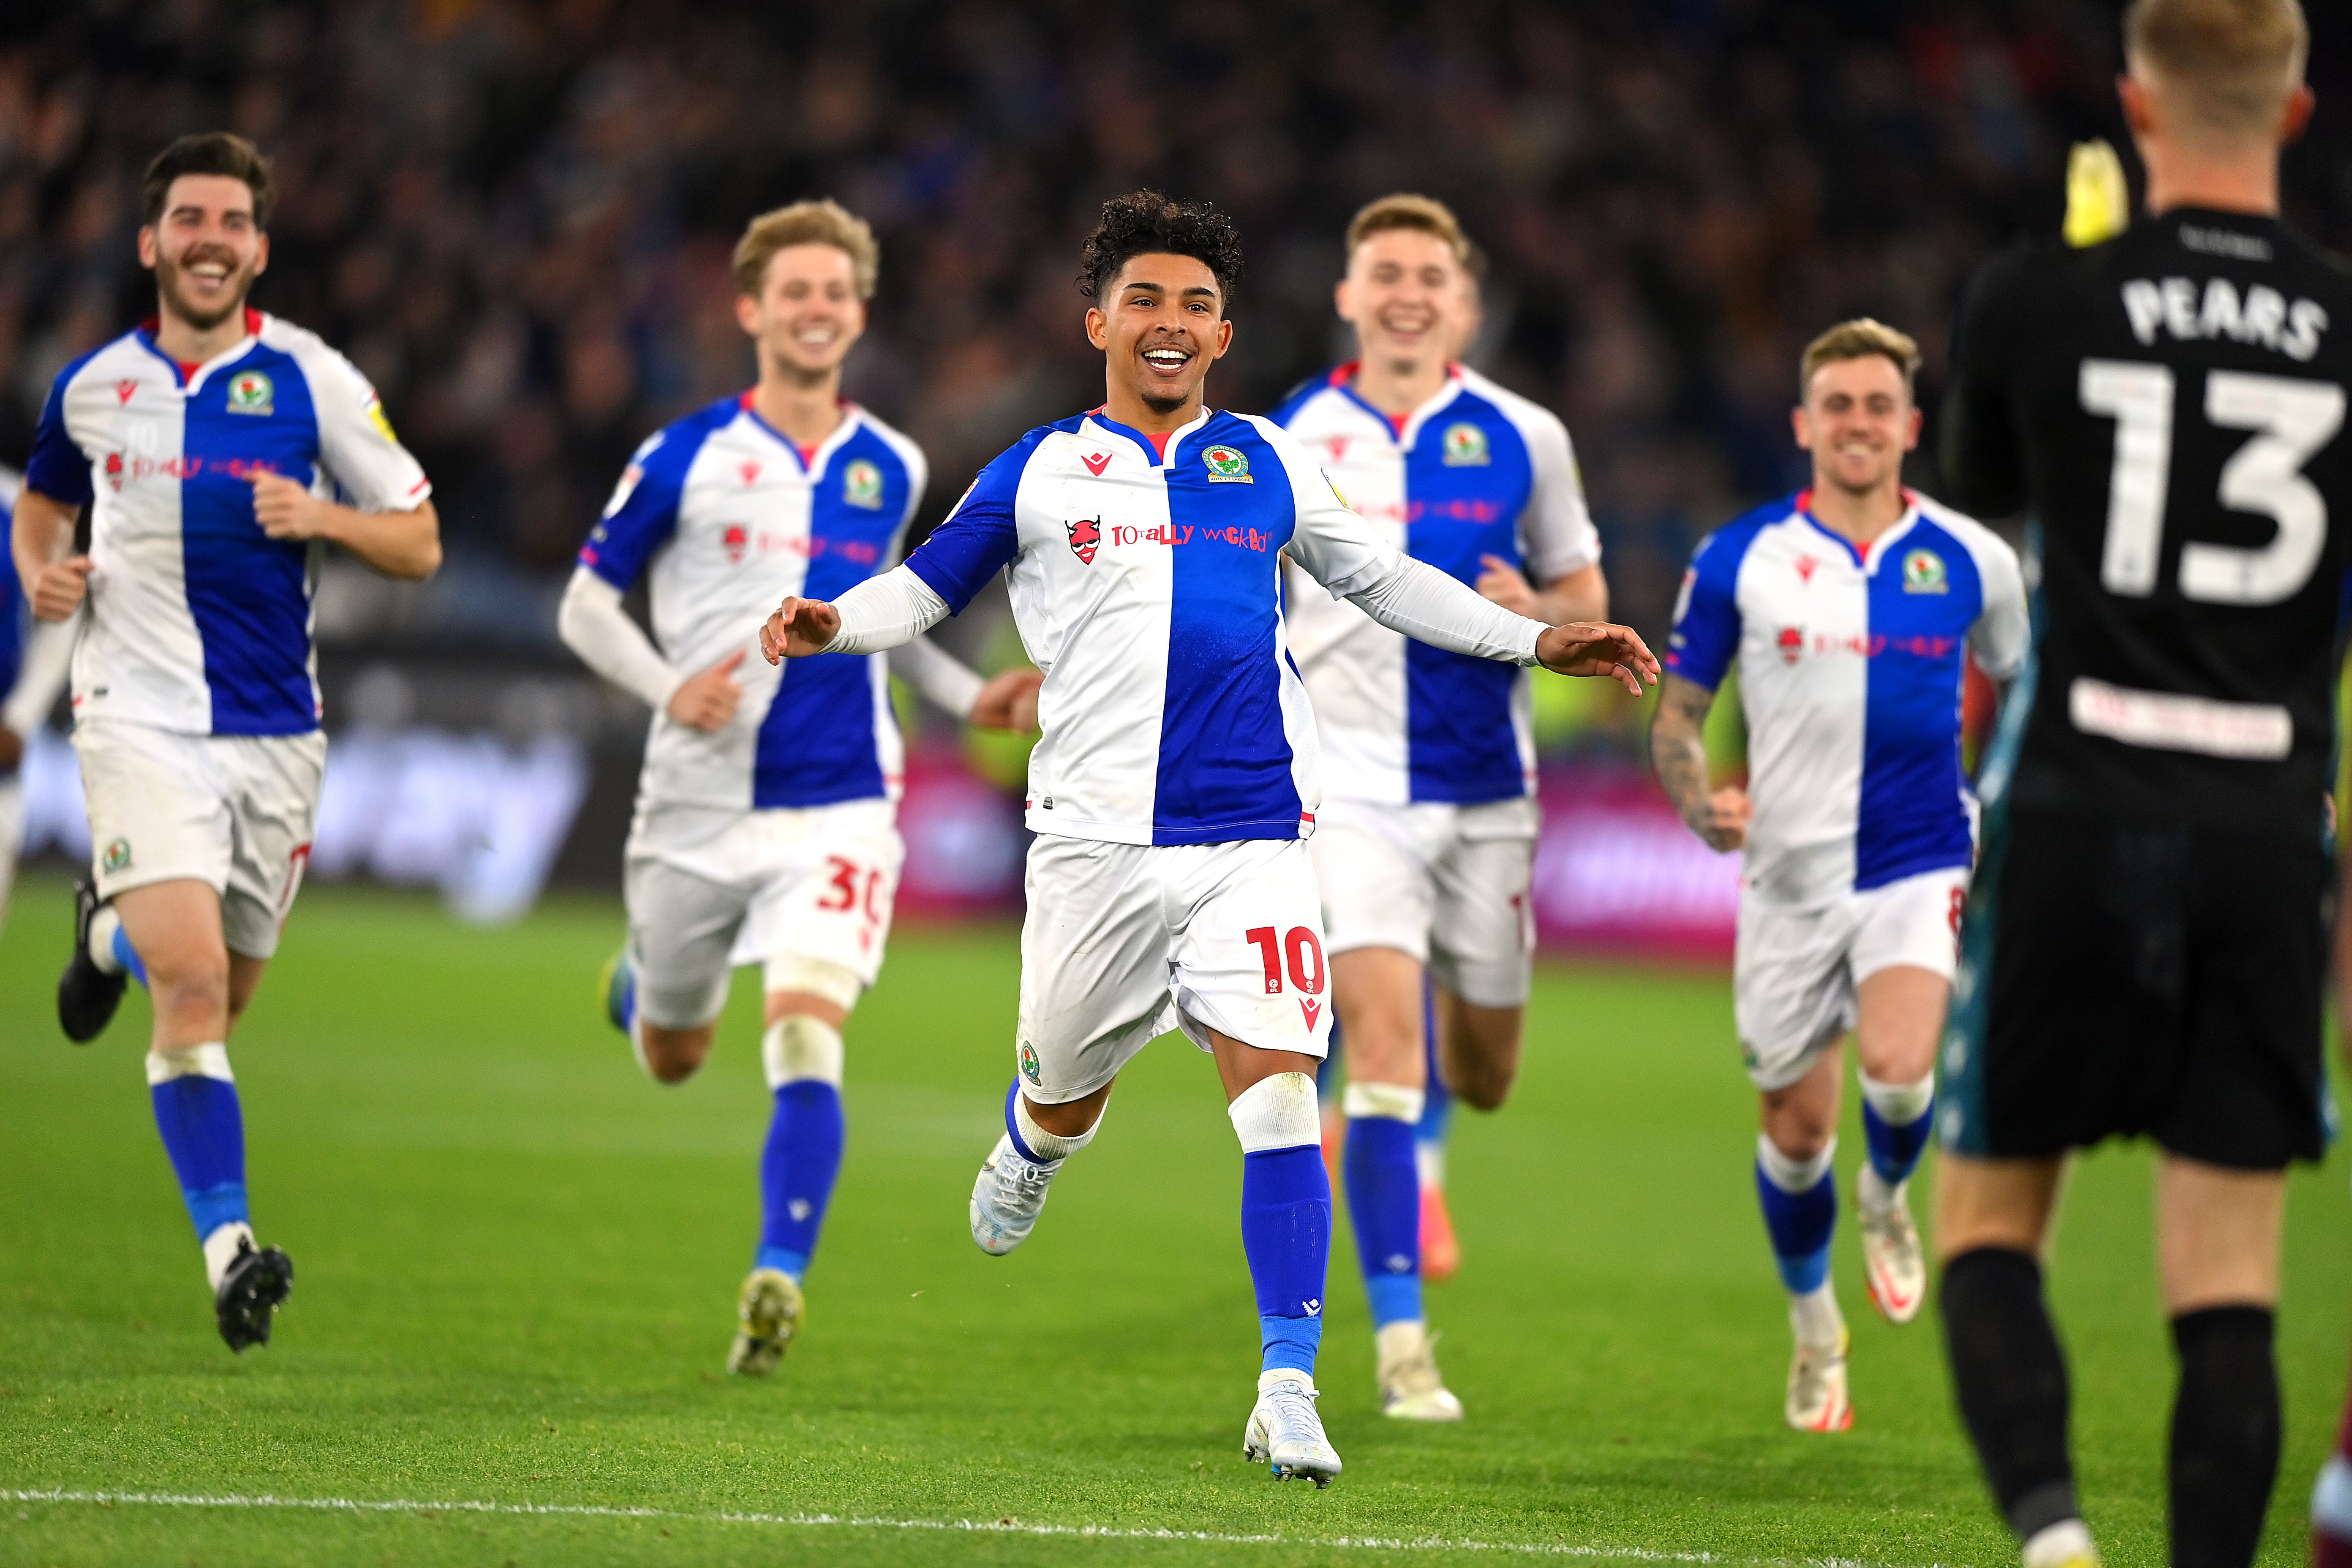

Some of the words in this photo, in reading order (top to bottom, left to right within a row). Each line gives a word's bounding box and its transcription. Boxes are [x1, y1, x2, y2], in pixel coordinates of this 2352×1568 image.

[2120, 275, 2329, 362] PEARS
[1203, 446, 1220, 468] BLACKBURN
[1220, 446, 1244, 459] ROVERS
[2077, 356, 2347, 607] 13
[1246, 926, 1325, 995] 10
